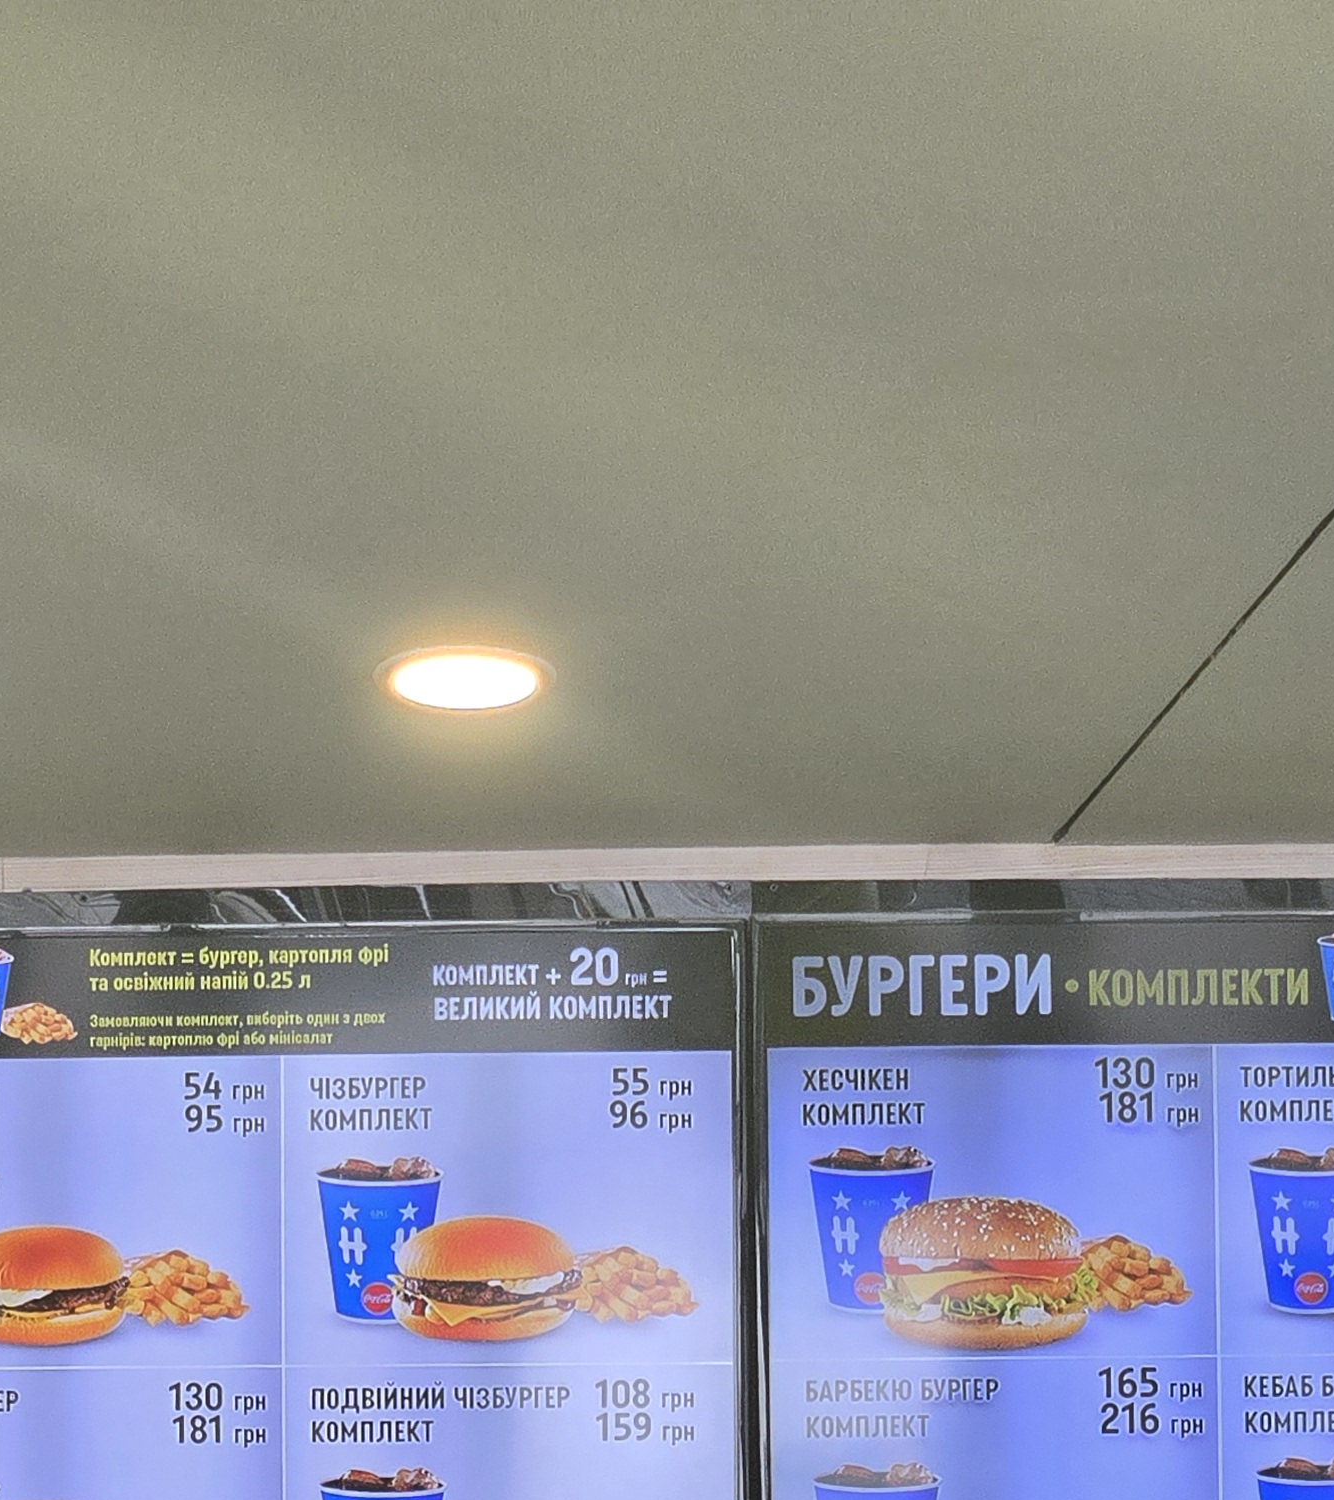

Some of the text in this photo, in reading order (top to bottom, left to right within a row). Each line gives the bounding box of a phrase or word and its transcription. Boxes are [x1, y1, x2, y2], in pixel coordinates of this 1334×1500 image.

[90, 944, 389, 969] Комплект бургер, картопля фрі
[433, 963, 540, 988] КОМПЛЕКТ
[570, 948, 618, 986] 20
[625, 971, 648, 988] грн
[90, 971, 311, 991] та освіжний напій 0.25 л
[791, 954, 1309, 1018] БУРГЕРИ КОМПЛЕКТИ
[434, 994, 672, 1021] ВЕЛИКИЙ КОМПЛЕКТ
[244, 1031, 265, 1044] або
[184, 1073, 265, 1104] 54 грн
[309, 1077, 426, 1100] ЧІЗБУРГЕР
[611, 1068, 692, 1100] 55 грн
[803, 1068, 908, 1091] ХЕСЧІКЕН
[1094, 1058, 1198, 1091] 130 грн
[185, 1105, 266, 1135] 95 грн
[309, 1107, 432, 1130] КОМПЛЕКТ
[609, 1101, 692, 1132] 96 грн
[169, 1383, 267, 1413] 130 грн
[311, 1384, 570, 1411] ПОДВІЙНИЙ ЧІЗБУРГЕР
[595, 1380, 695, 1411] 108 грн
[806, 1378, 999, 1401] БАРБЕКЮ БУРГЕР
[1099, 1367, 1203, 1401] 165 грн
[1244, 1375, 1313, 1397] КЕБАБ
